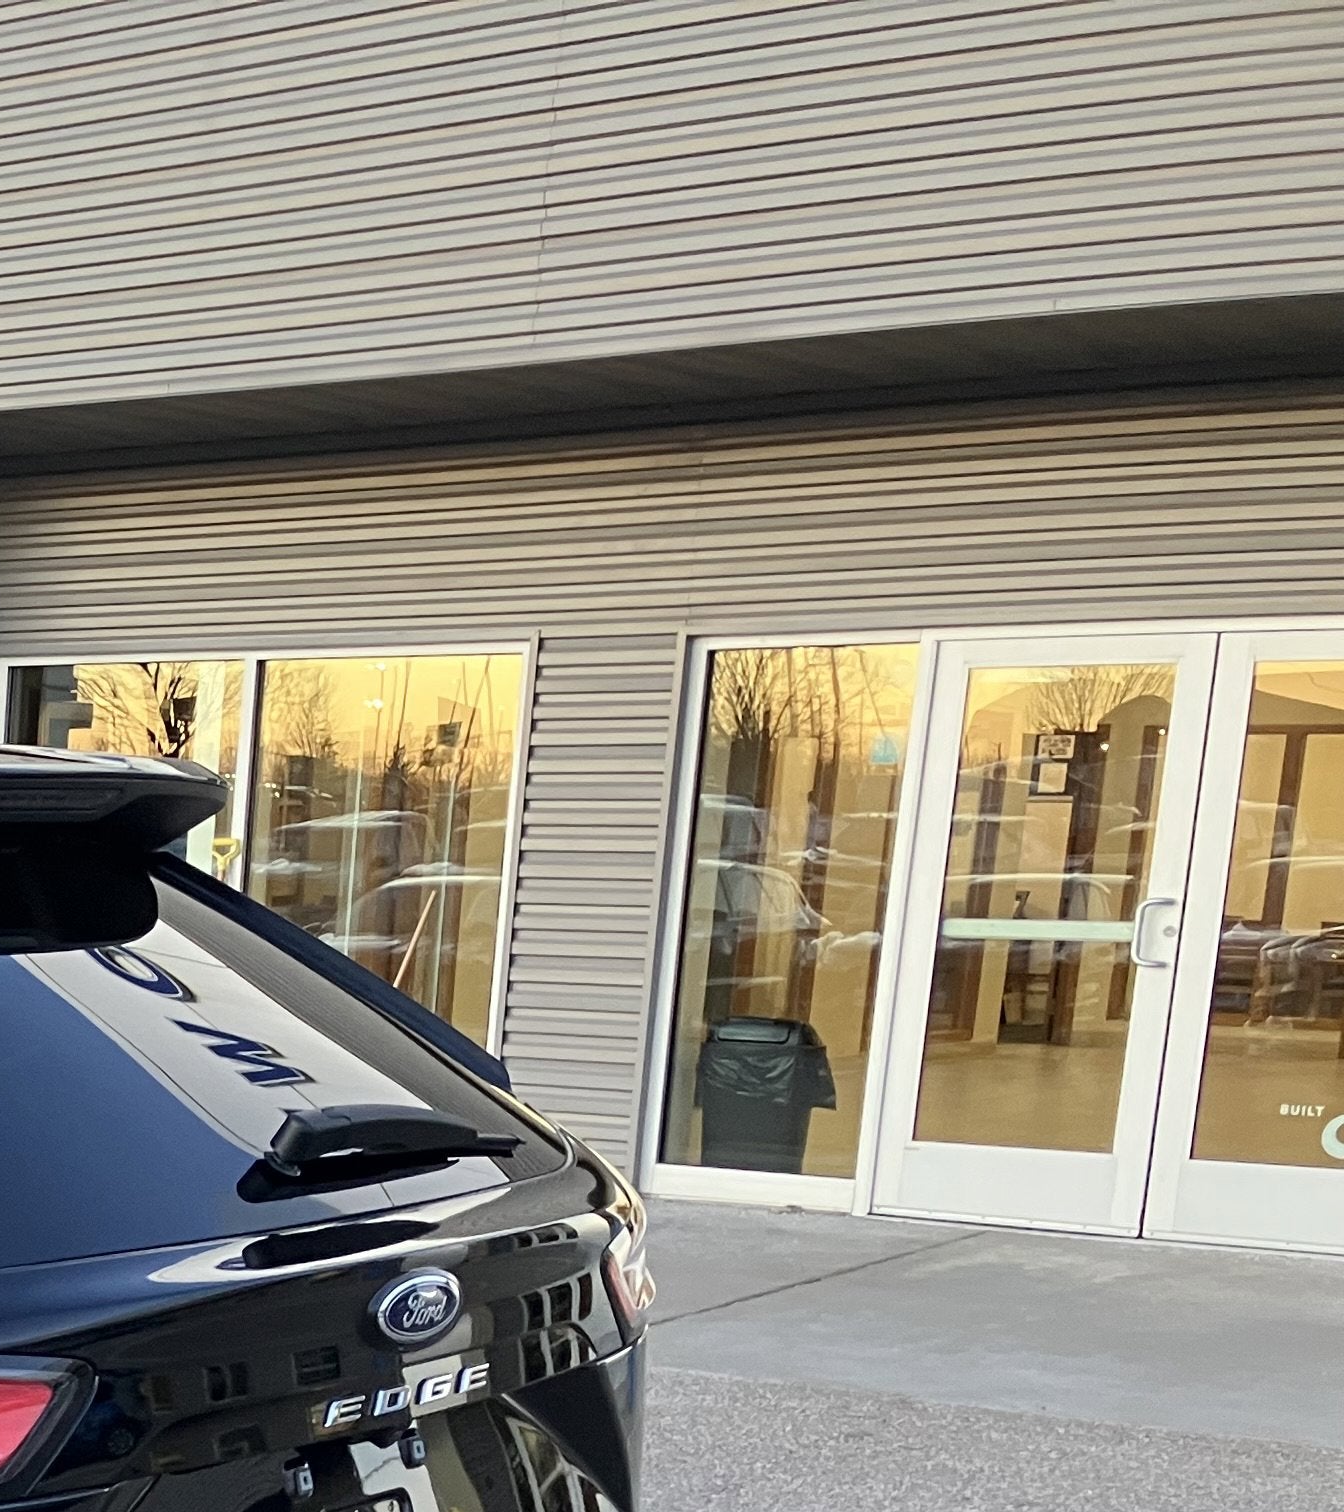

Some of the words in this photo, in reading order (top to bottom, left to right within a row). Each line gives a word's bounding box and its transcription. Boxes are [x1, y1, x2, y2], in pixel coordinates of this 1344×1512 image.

[1279, 1103, 1326, 1117] BUILT
[402, 1291, 448, 1328] Ford
[322, 1363, 490, 1428] EDGE
